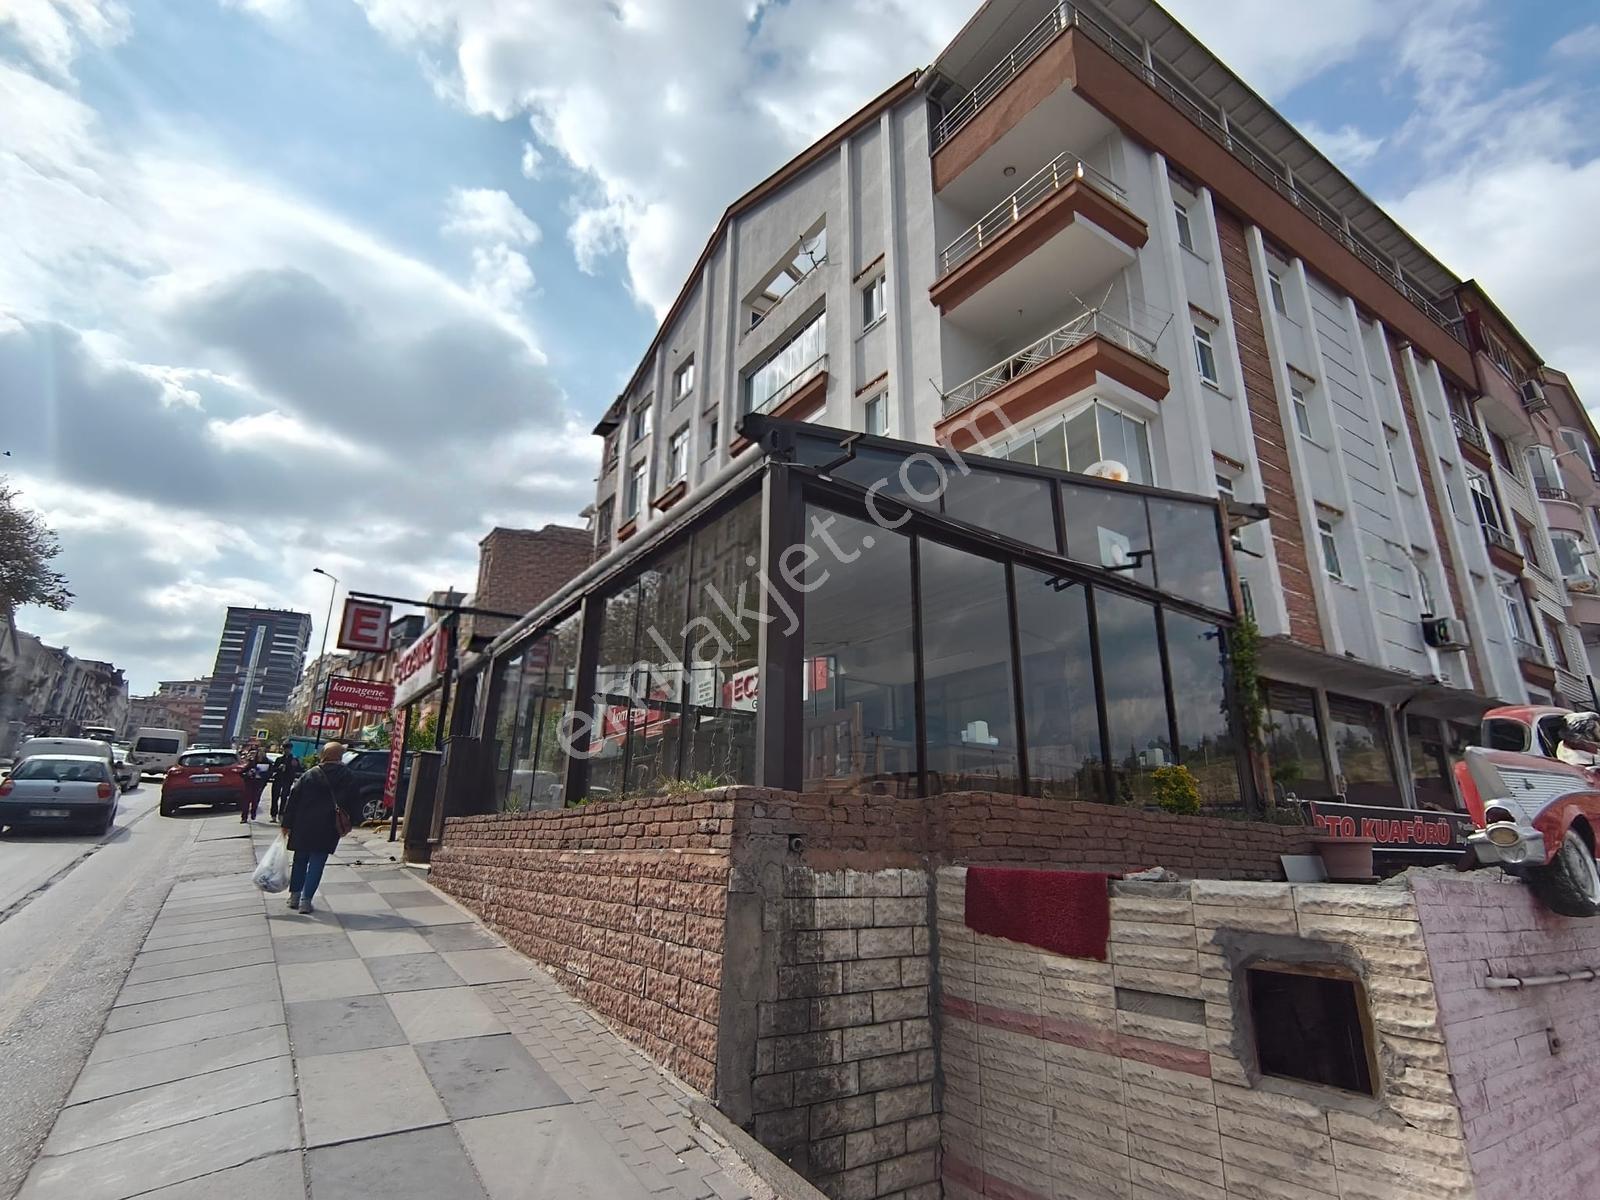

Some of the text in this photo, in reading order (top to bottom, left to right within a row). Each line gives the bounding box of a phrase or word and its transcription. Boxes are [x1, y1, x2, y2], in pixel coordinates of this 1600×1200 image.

[349, 607, 382, 644] E
[333, 682, 385, 697] komagene
[1361, 815, 1450, 845] KUAFÖRÜ
